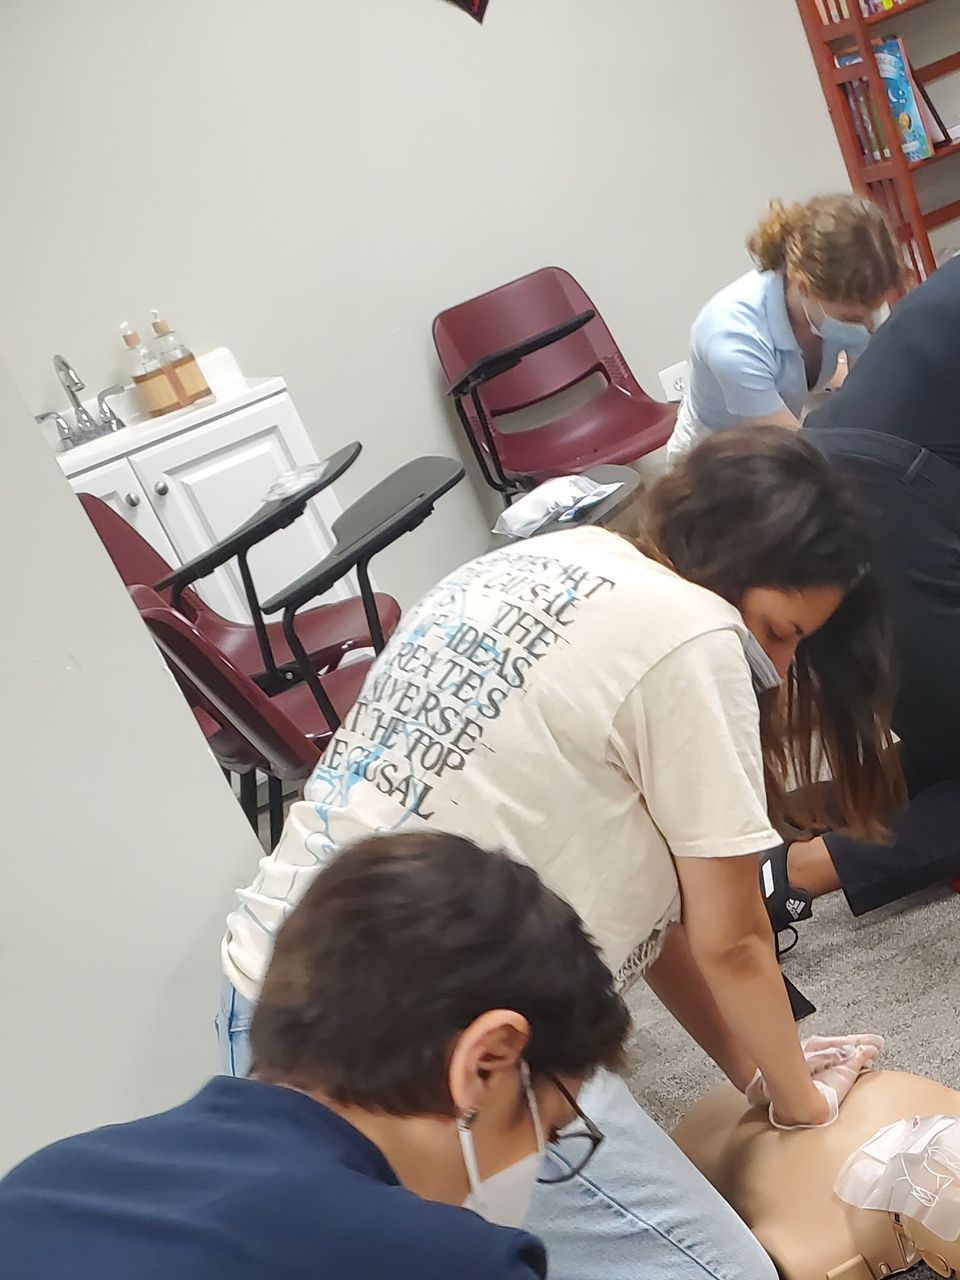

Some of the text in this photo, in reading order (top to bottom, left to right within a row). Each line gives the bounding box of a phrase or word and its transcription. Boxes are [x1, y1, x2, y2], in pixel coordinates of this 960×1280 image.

[445, 622, 532, 688] IDEAS
[491, 601, 560, 660] THE
[388, 642, 508, 719] REATES
[404, 728, 466, 777] TOP
